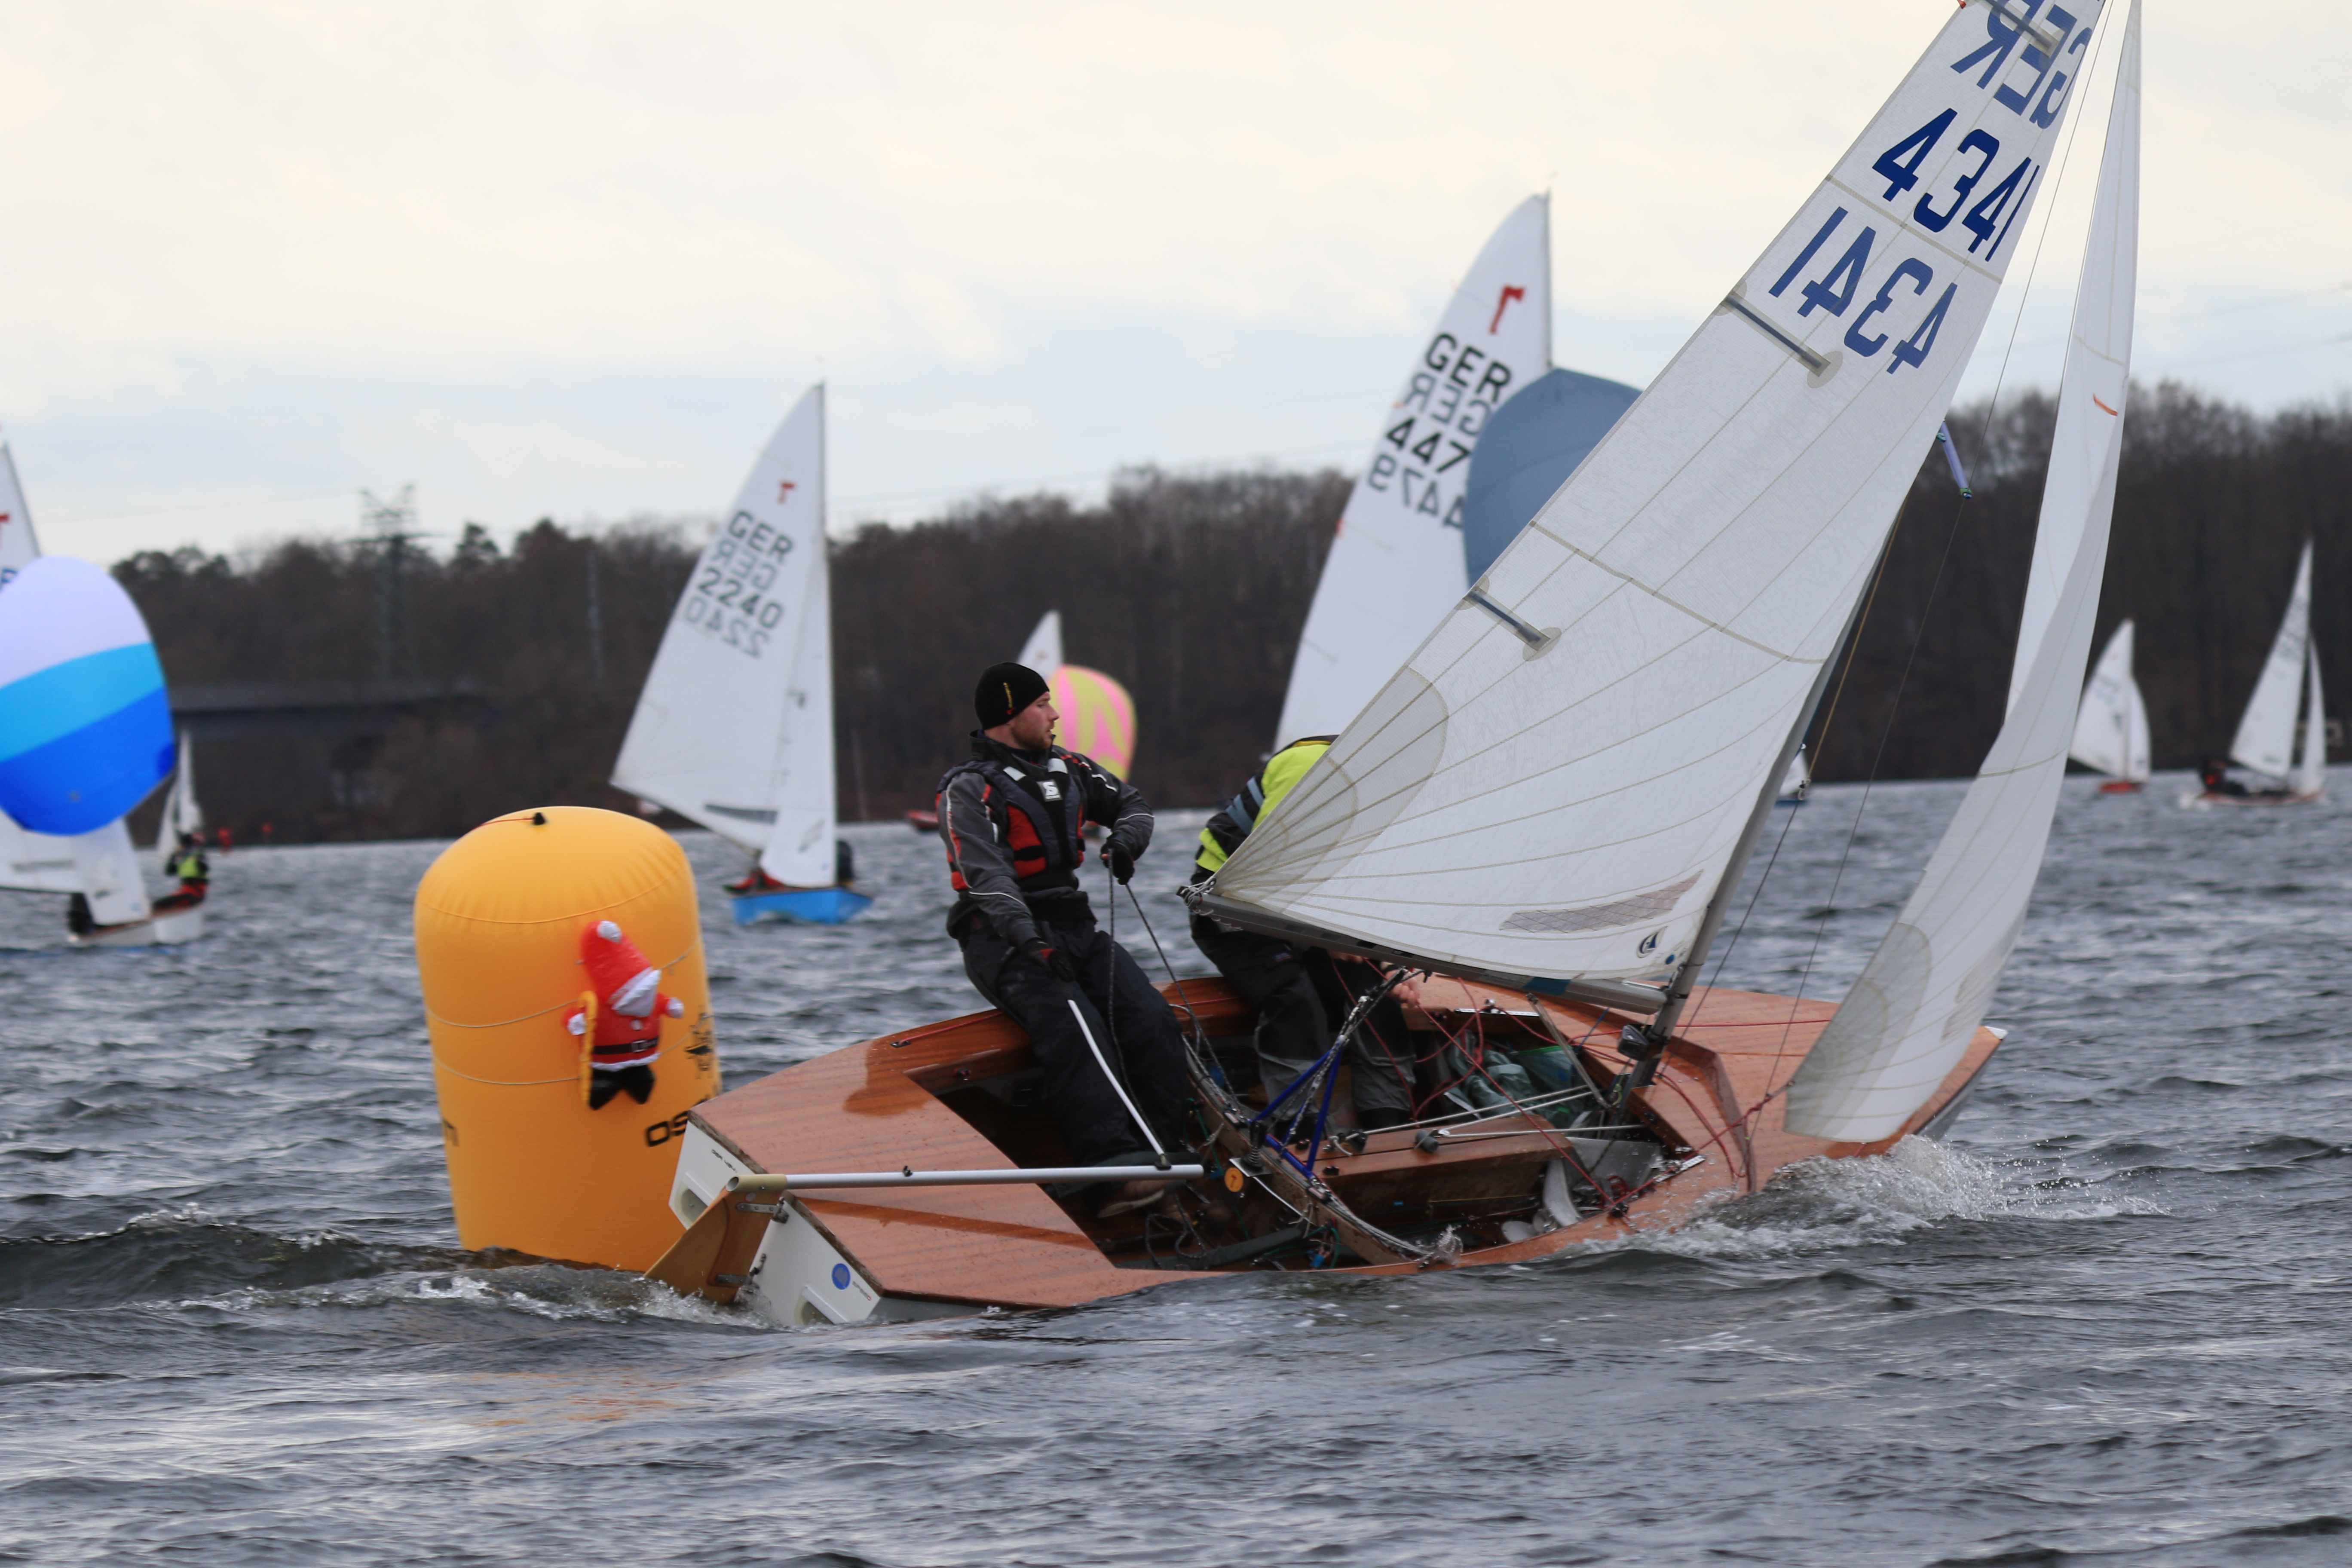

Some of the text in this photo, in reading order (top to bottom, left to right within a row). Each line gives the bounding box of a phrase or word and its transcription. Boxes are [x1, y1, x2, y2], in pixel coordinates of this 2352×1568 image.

[1872, 107, 2040, 262] 4341
[1424, 332, 1512, 403] GER
[727, 510, 793, 564] GER
[697, 567, 783, 629] 2240
